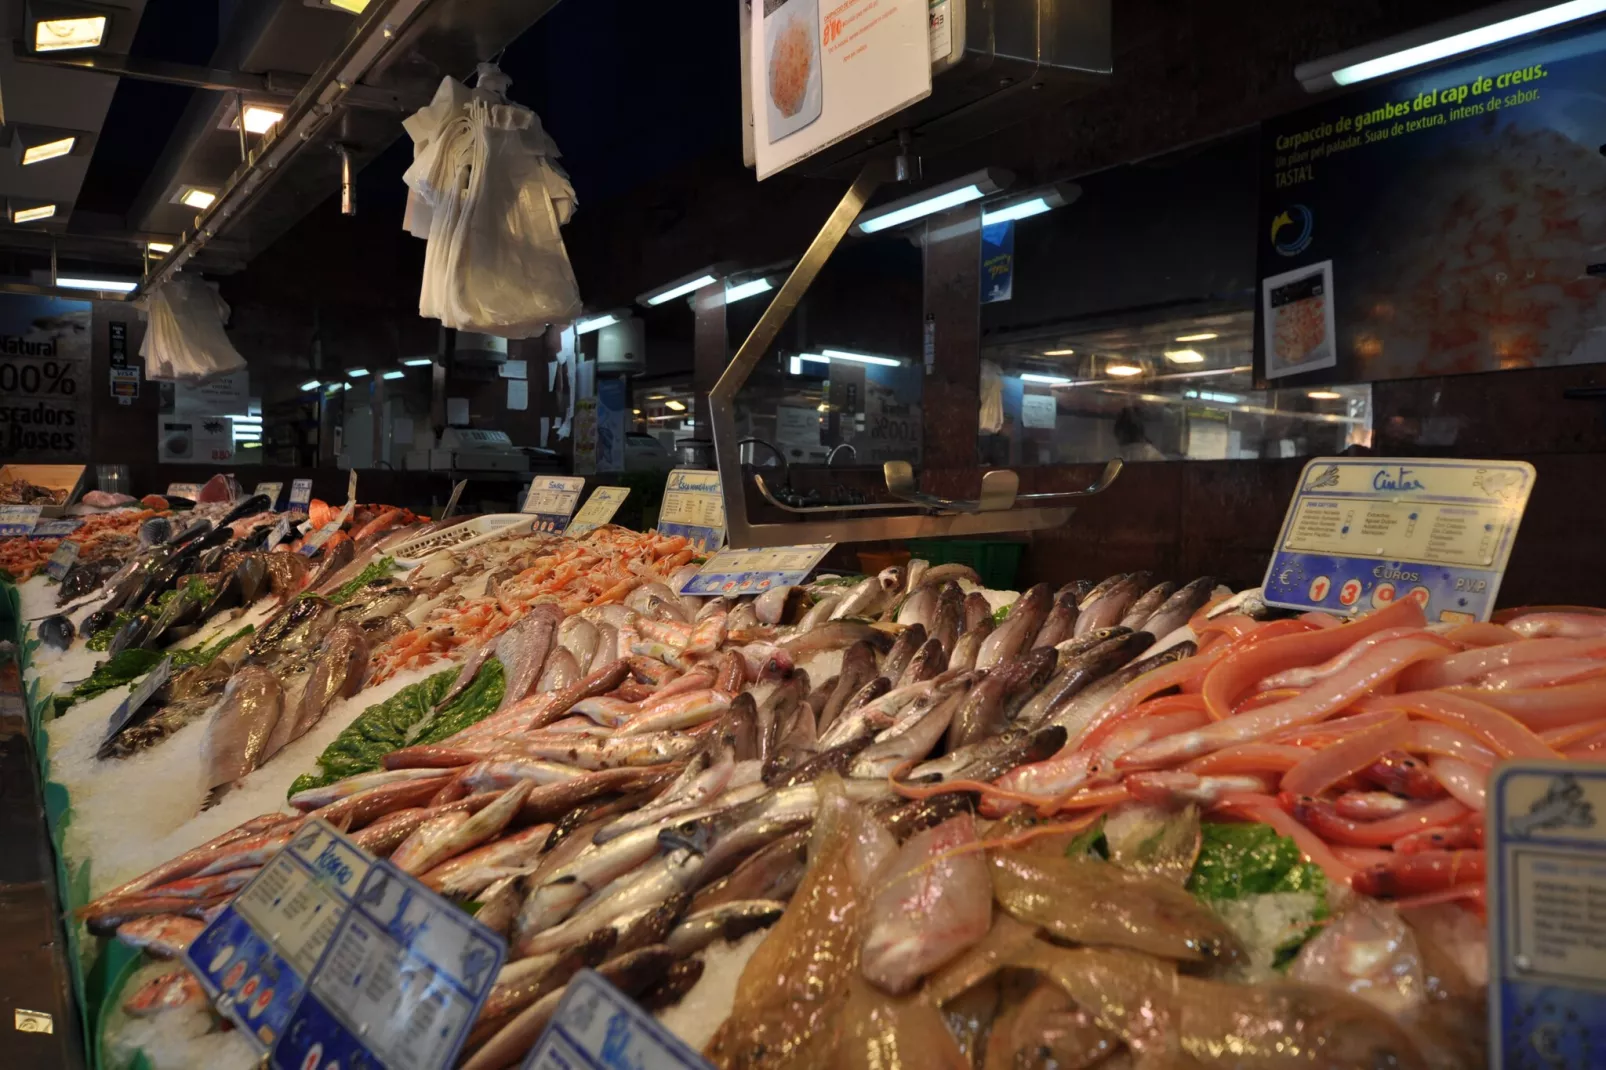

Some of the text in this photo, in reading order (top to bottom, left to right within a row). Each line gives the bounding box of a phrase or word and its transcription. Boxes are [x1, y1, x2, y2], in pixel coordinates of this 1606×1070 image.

[1276, 63, 1549, 151] Carpaccio de gambes del cap de creus.
[1311, 144, 1325, 163] pel
[1365, 125, 1389, 143] Suau
[1391, 121, 1405, 136] de
[1406, 112, 1448, 134] textura,
[1449, 102, 1485, 122] intens
[1486, 95, 1502, 111] de
[1504, 86, 1541, 106] sabor.
